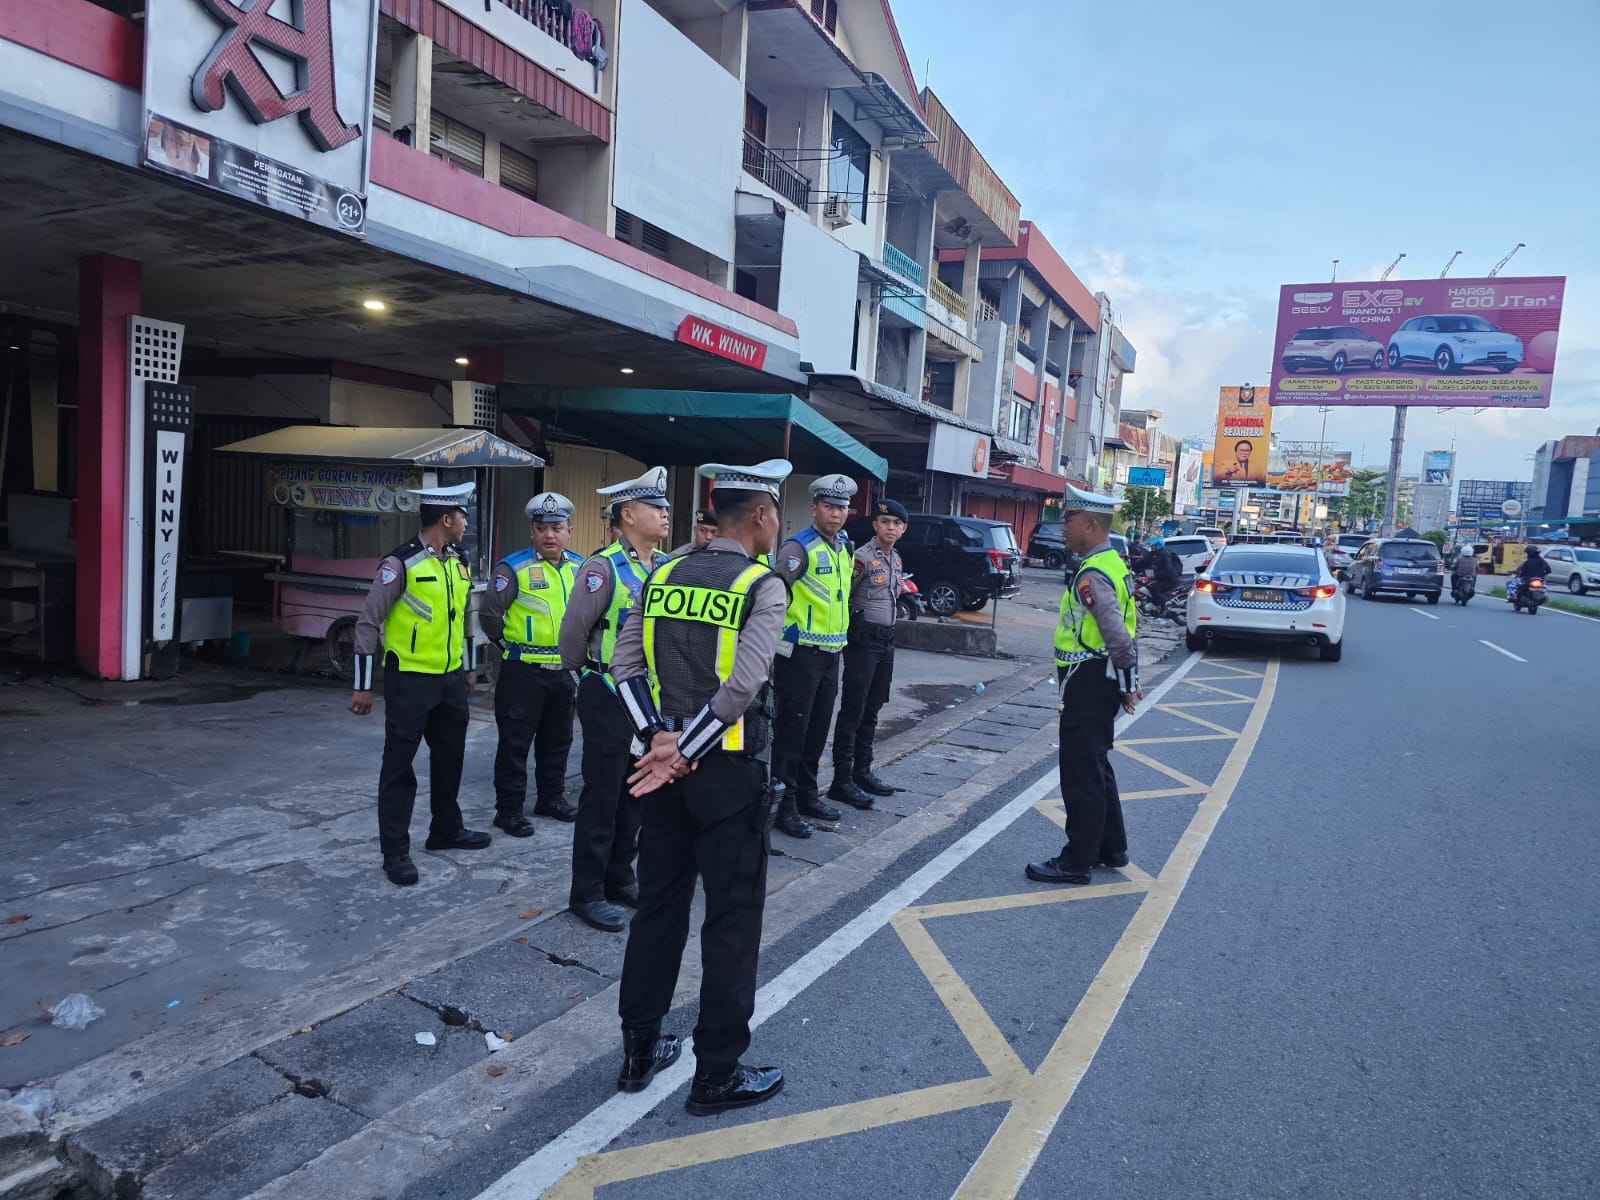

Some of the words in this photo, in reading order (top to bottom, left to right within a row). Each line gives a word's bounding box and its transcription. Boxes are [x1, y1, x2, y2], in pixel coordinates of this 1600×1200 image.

[254, 160, 304, 185] PERINGATAN:
[341, 202, 360, 218] 21+
[1342, 289, 1404, 308] EX2
[1404, 297, 1424, 306] EV
[1448, 287, 1495, 296] HARGA
[1291, 306, 1332, 314] GEELY
[1450, 296, 1495, 308] 200
[1342, 307, 1376, 315] BRAND
[1378, 307, 1395, 315] NO.
[1360, 315, 1391, 323] CHINA
[718, 333, 757, 361] WINNY
[1224, 417, 1264, 427] INDONESIA
[1223, 427, 1264, 437] SEJAHTERA
[279, 467, 314, 481] PISANG
[318, 468, 358, 483] GORENG
[362, 470, 405, 485] SRIKAYA
[161, 449, 179, 543] WINNY
[310, 486, 373, 507] WINNY
[646, 587, 739, 625] POLISI
